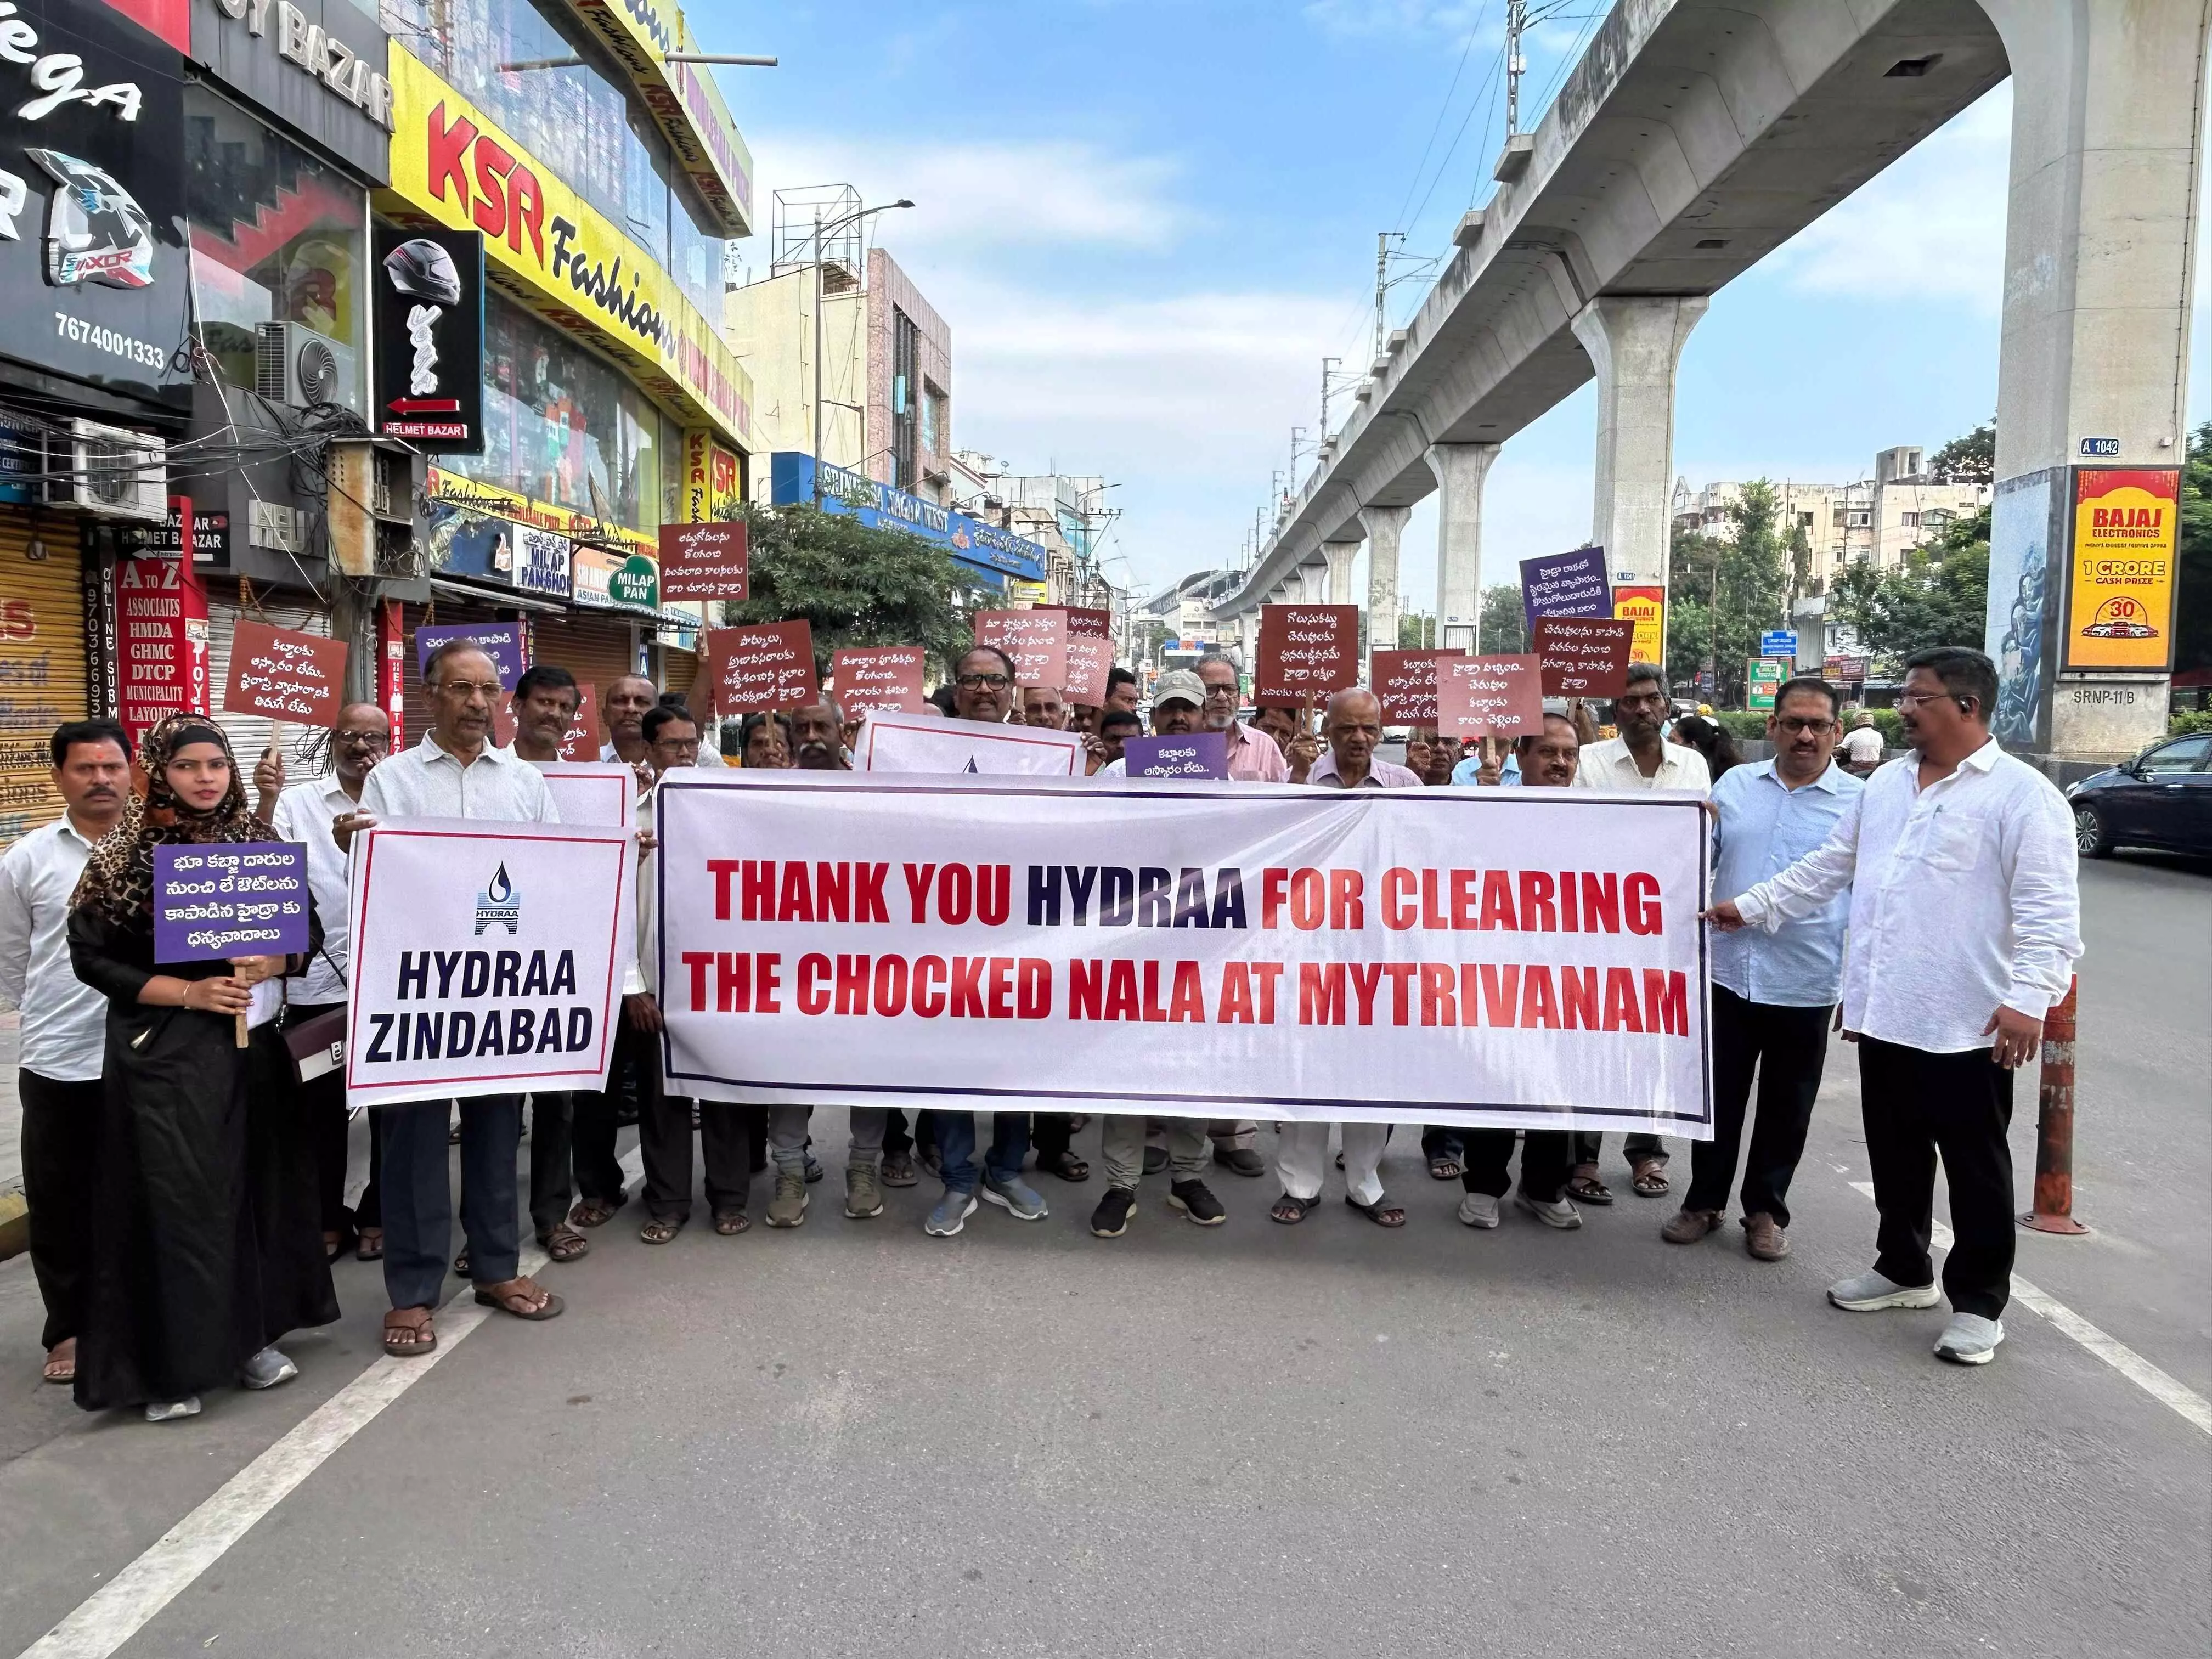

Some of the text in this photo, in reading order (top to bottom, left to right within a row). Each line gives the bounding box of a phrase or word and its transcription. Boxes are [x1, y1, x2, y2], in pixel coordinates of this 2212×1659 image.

[279, 0, 396, 133] BAZAR
[428, 99, 675, 360] KSR Fashions
[55, 312, 164, 369] 7674001333
[386, 423, 461, 436] HELMET BAZAR
[2081, 440, 2119, 454] A 1042
[690, 434, 706, 484] KSR
[2093, 508, 2162, 528] BAJAJ
[122, 531, 167, 545] HMET
[2092, 529, 2160, 538] ELECTRONICS
[532, 548, 565, 572] MILAP
[2083, 560, 2166, 577] 1 CRORE
[120, 561, 181, 590] A TO Z
[618, 572, 655, 588] MILAP
[577, 589, 599, 603] ASIAN
[624, 586, 647, 599] PAN
[103, 567, 114, 651] ONLINE
[127, 597, 181, 618] ASSOCIATES
[2110, 600, 2135, 617] 30
[129, 622, 174, 639] HMDA
[87, 590, 101, 720] 97036693
[130, 644, 175, 661] GHMC
[131, 664, 176, 681] DTCP
[127, 685, 183, 702] MUNICIPALITY
[174, 853, 295, 874] భూ కబ్జా దారుల
[166, 881, 215, 895] నుంచి
[219, 875, 235, 893] లే
[707, 859, 1663, 935] THANK YOU HYDRAA FOR CLEARING
[165, 901, 301, 922] కాపాడిన హైడ్రా కు
[475, 910, 520, 918] HYDRAA
[187, 928, 280, 949] ధన్యవాదాలు
[397, 949, 577, 1000] HYDRAA
[682, 951, 1689, 1037] THE CHOCKED NALA AT MYTRIVANAM
[365, 1007, 594, 1063] ZINDABAD
